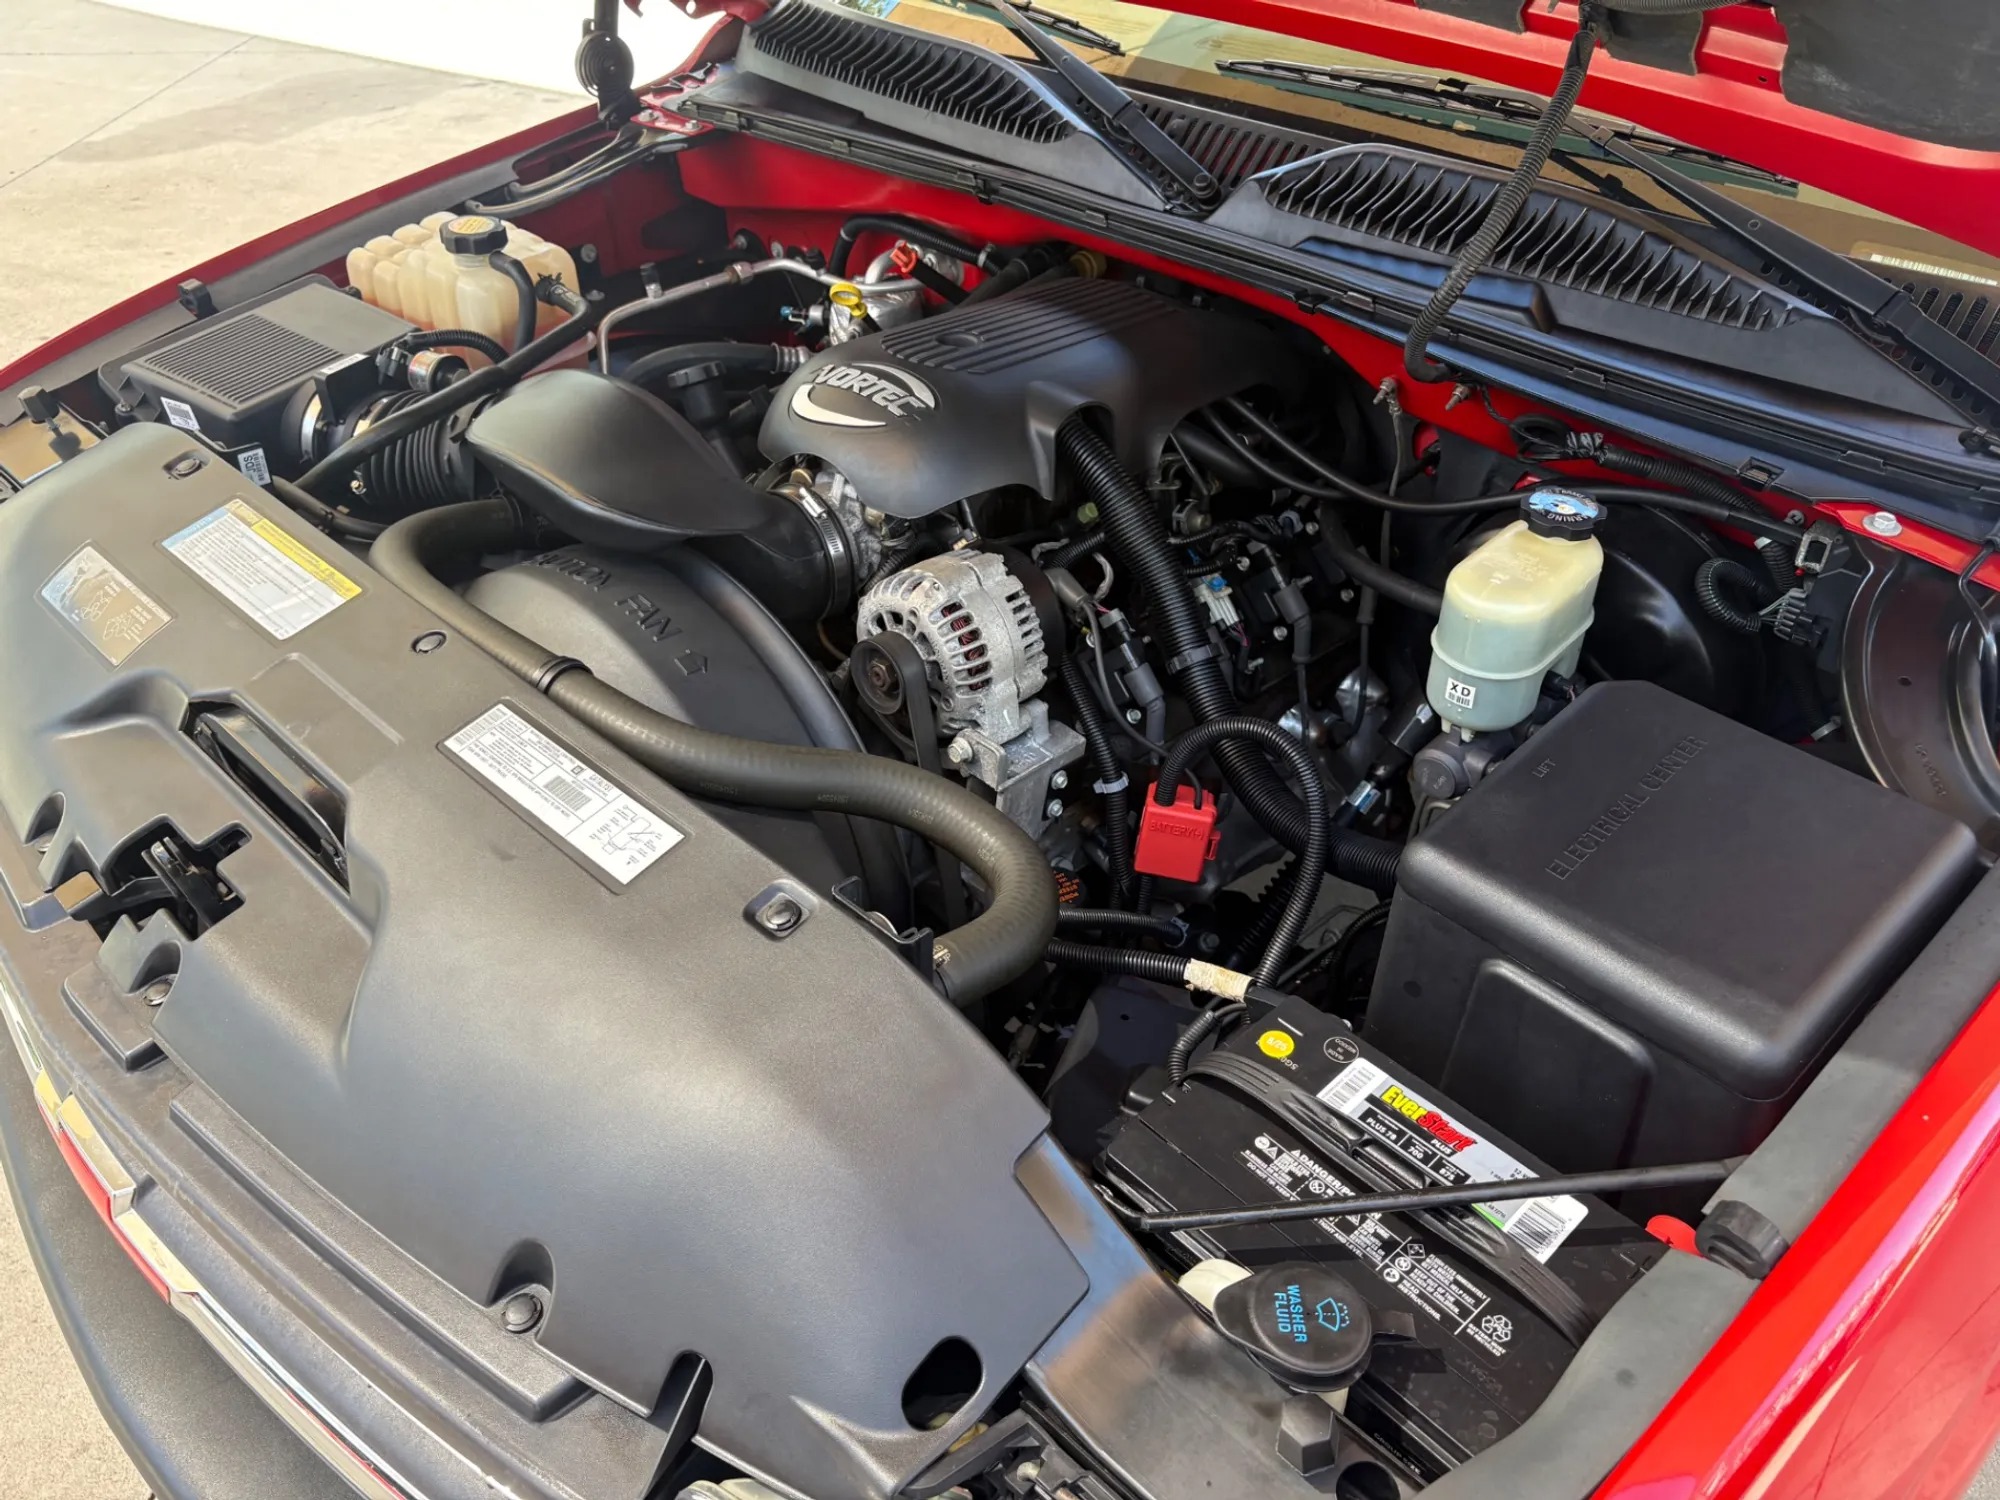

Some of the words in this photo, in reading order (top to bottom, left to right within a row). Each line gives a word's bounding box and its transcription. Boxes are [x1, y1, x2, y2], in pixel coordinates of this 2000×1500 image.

[814, 363, 926, 416] VORTEC
[244, 455, 255, 471] JDS
[521, 554, 612, 592] AUTION
[614, 593, 682, 642] FAN
[1531, 757, 1556, 777] LIFT
[1543, 791, 1651, 881] ELECTRICAL
[1637, 732, 1708, 793] CENTER
[1365, 1117, 1386, 1133] PLUS
[1385, 1130, 1397, 1140] 78
[1379, 1083, 1477, 1153] EverStart
[1406, 1146, 1424, 1159] 700
[1429, 1138, 1454, 1155] PLUS
[1438, 1168, 1455, 1180] 875
[1254, 1168, 1267, 1179] NOT
[1274, 1184, 1291, 1198] KEEP
[1317, 1219, 1336, 1234] TIGHT
[1333, 1232, 1347, 1243] AND
[1401, 1279, 1419, 1294] READ
[1408, 1272, 1427, 1287] REACH
[1412, 1268, 1427, 1280] KEEP
[1425, 1278, 1438, 1289] OUT
[1443, 1292, 1455, 1302] THE
[1429, 1268, 1451, 1286] MEDICAL
[1449, 1283, 1463, 1295] HELP
[1273, 1292, 1292, 1332] FLUID
[1285, 1284, 1308, 1342] WASHER
[1396, 1283, 1442, 1320] INSTRUCTIONS.
[1467, 1322, 1491, 1342] BATTERY
[1489, 1340, 1506, 1354] MUST
[1472, 1333, 1501, 1357] RECYCLED
